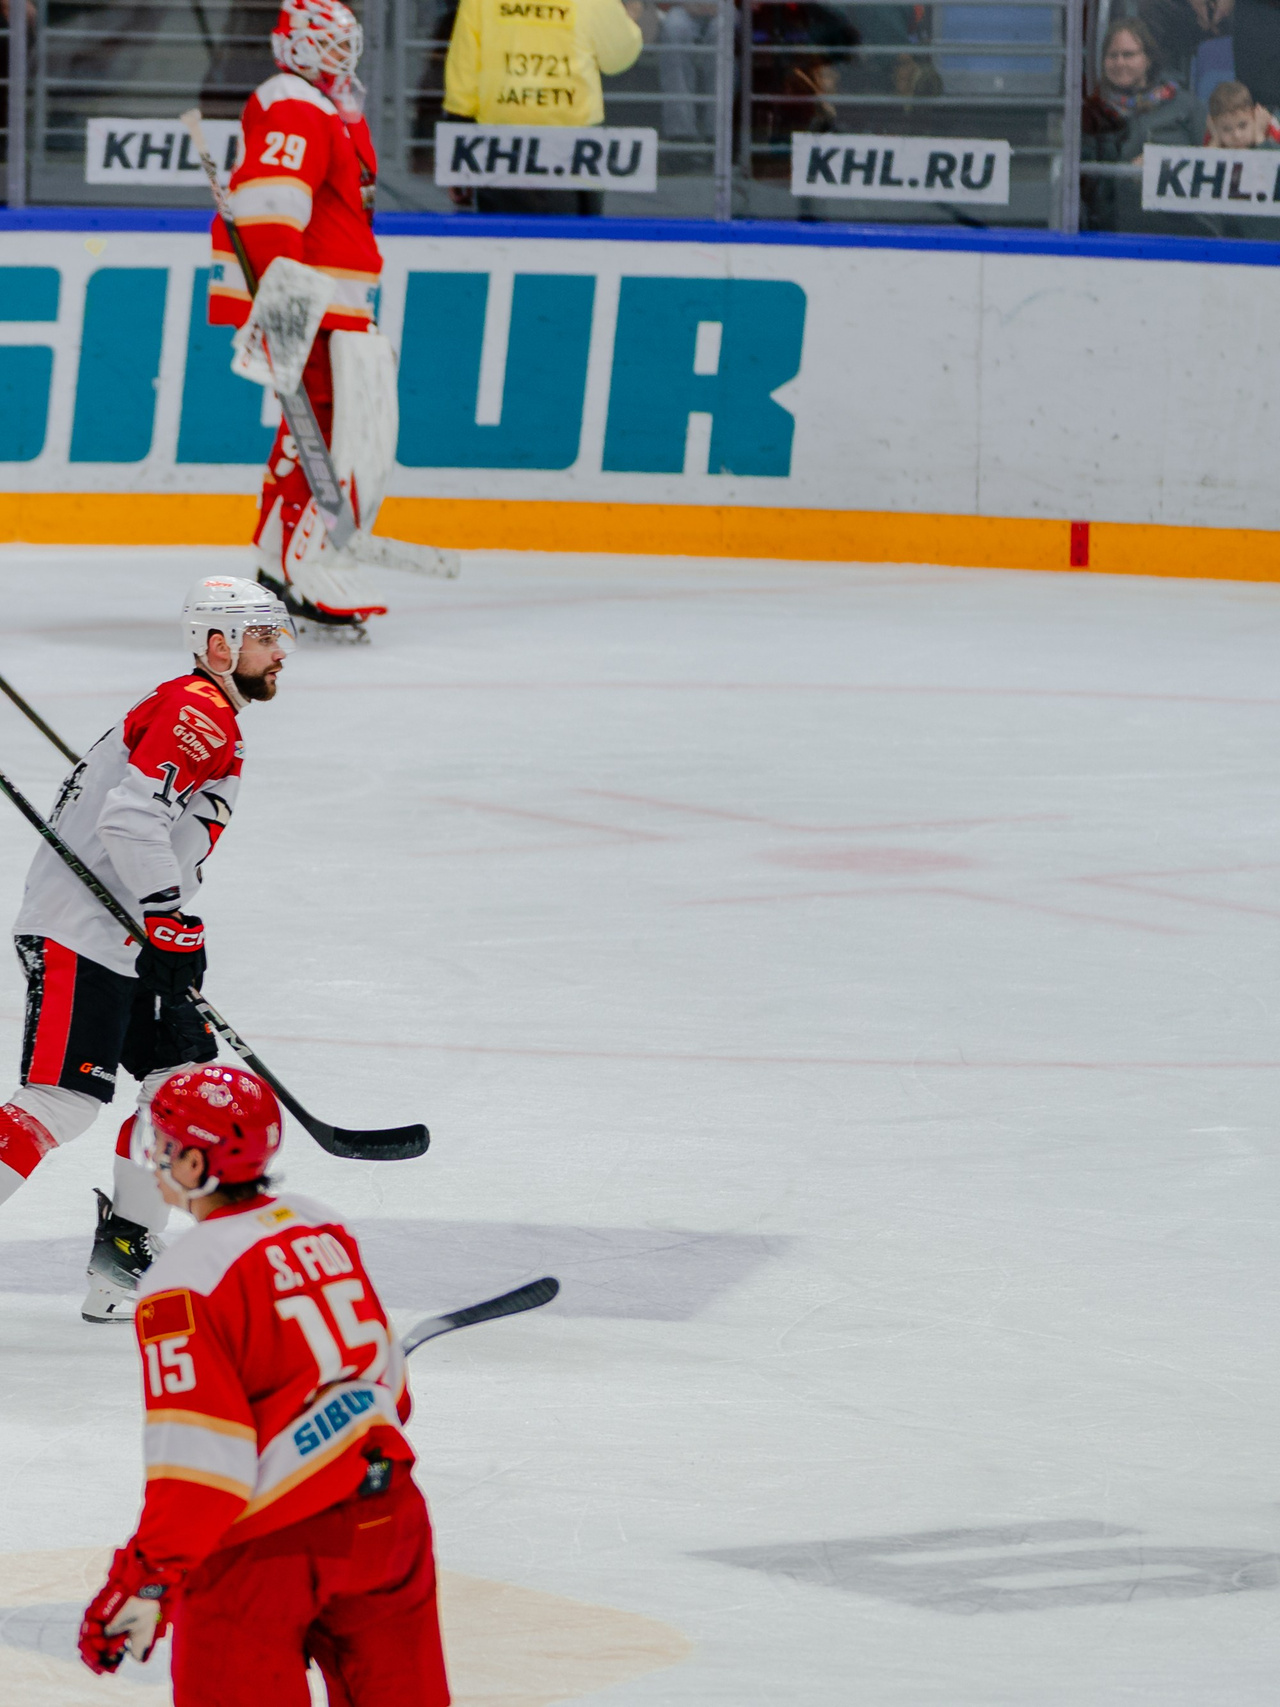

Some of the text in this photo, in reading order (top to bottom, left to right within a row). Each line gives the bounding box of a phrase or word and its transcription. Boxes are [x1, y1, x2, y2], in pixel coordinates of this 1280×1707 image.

[500, 3, 569, 21] SAFETY
[259, 131, 306, 170] 29
[451, 135, 642, 177] KHL.RU
[806, 146, 996, 190] KHL.RU
[1157, 158, 1280, 203] KHL.
[274, 1278, 390, 1387] 15
[144, 1336, 197, 1397] 15
